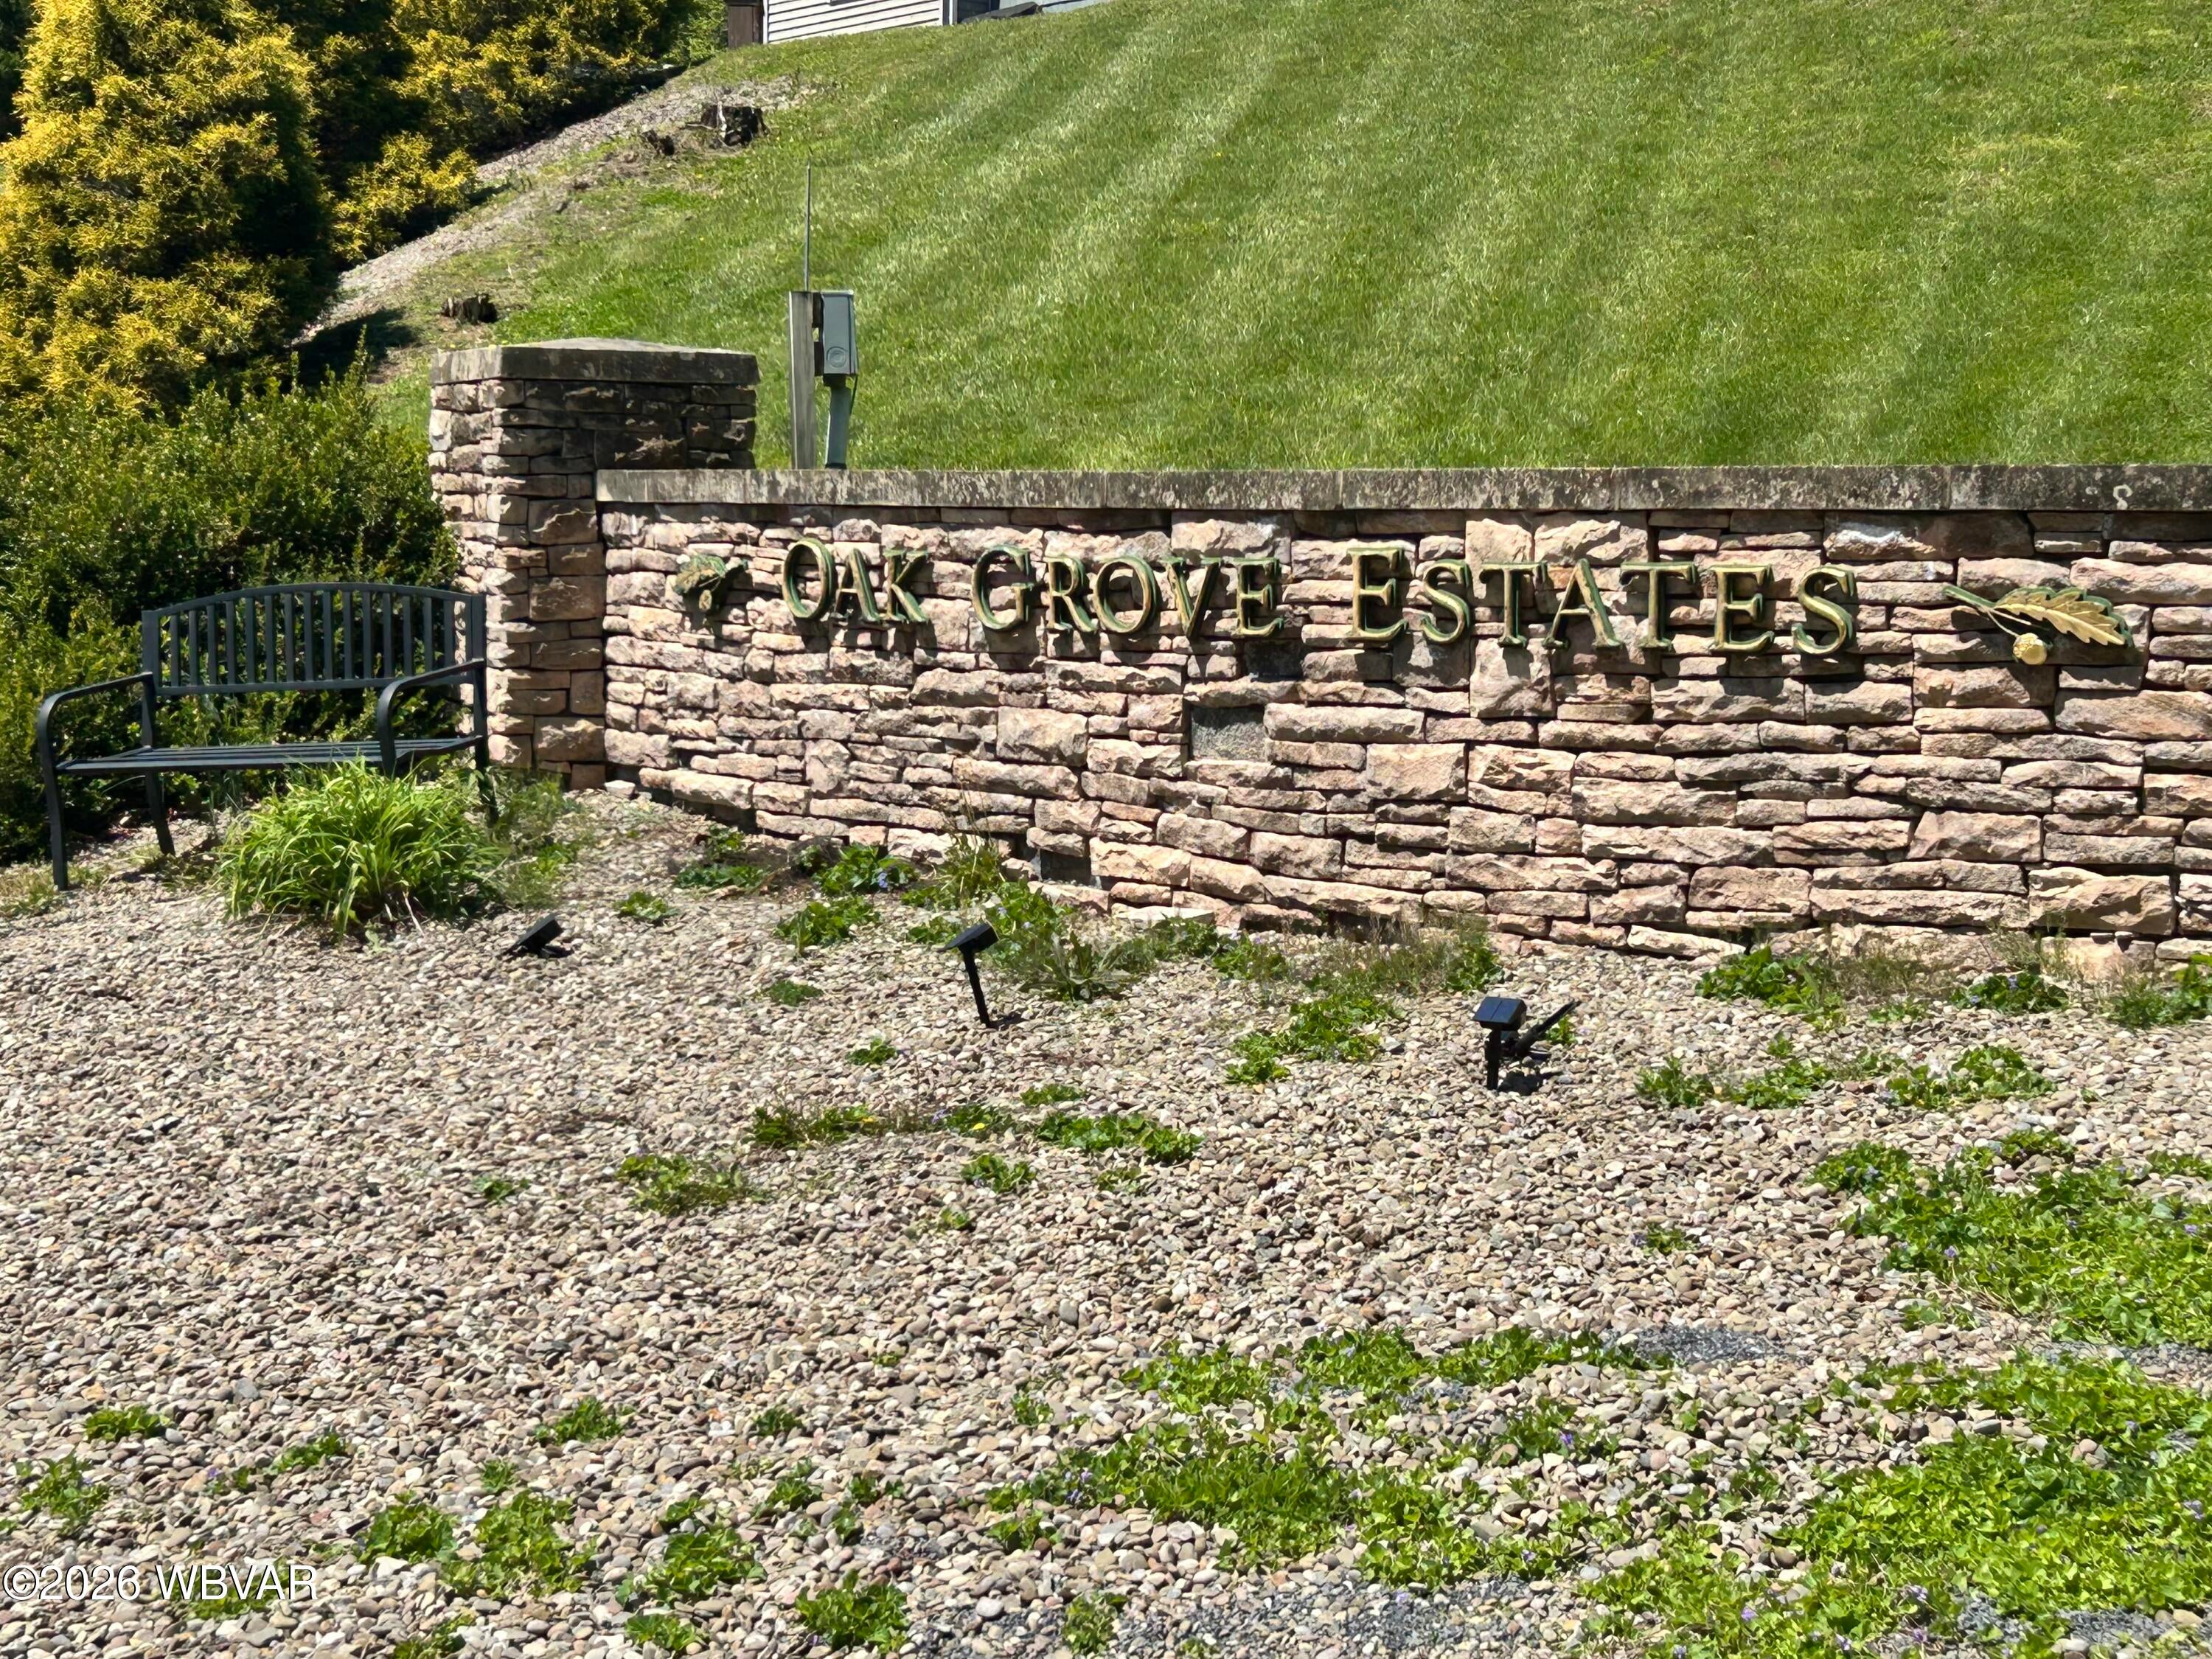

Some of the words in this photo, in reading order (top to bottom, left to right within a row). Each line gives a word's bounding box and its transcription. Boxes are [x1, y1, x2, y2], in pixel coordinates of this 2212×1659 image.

[781, 537, 931, 625] OAK
[970, 544, 1284, 639] GROVE
[1346, 546, 1857, 655] ESTATES
